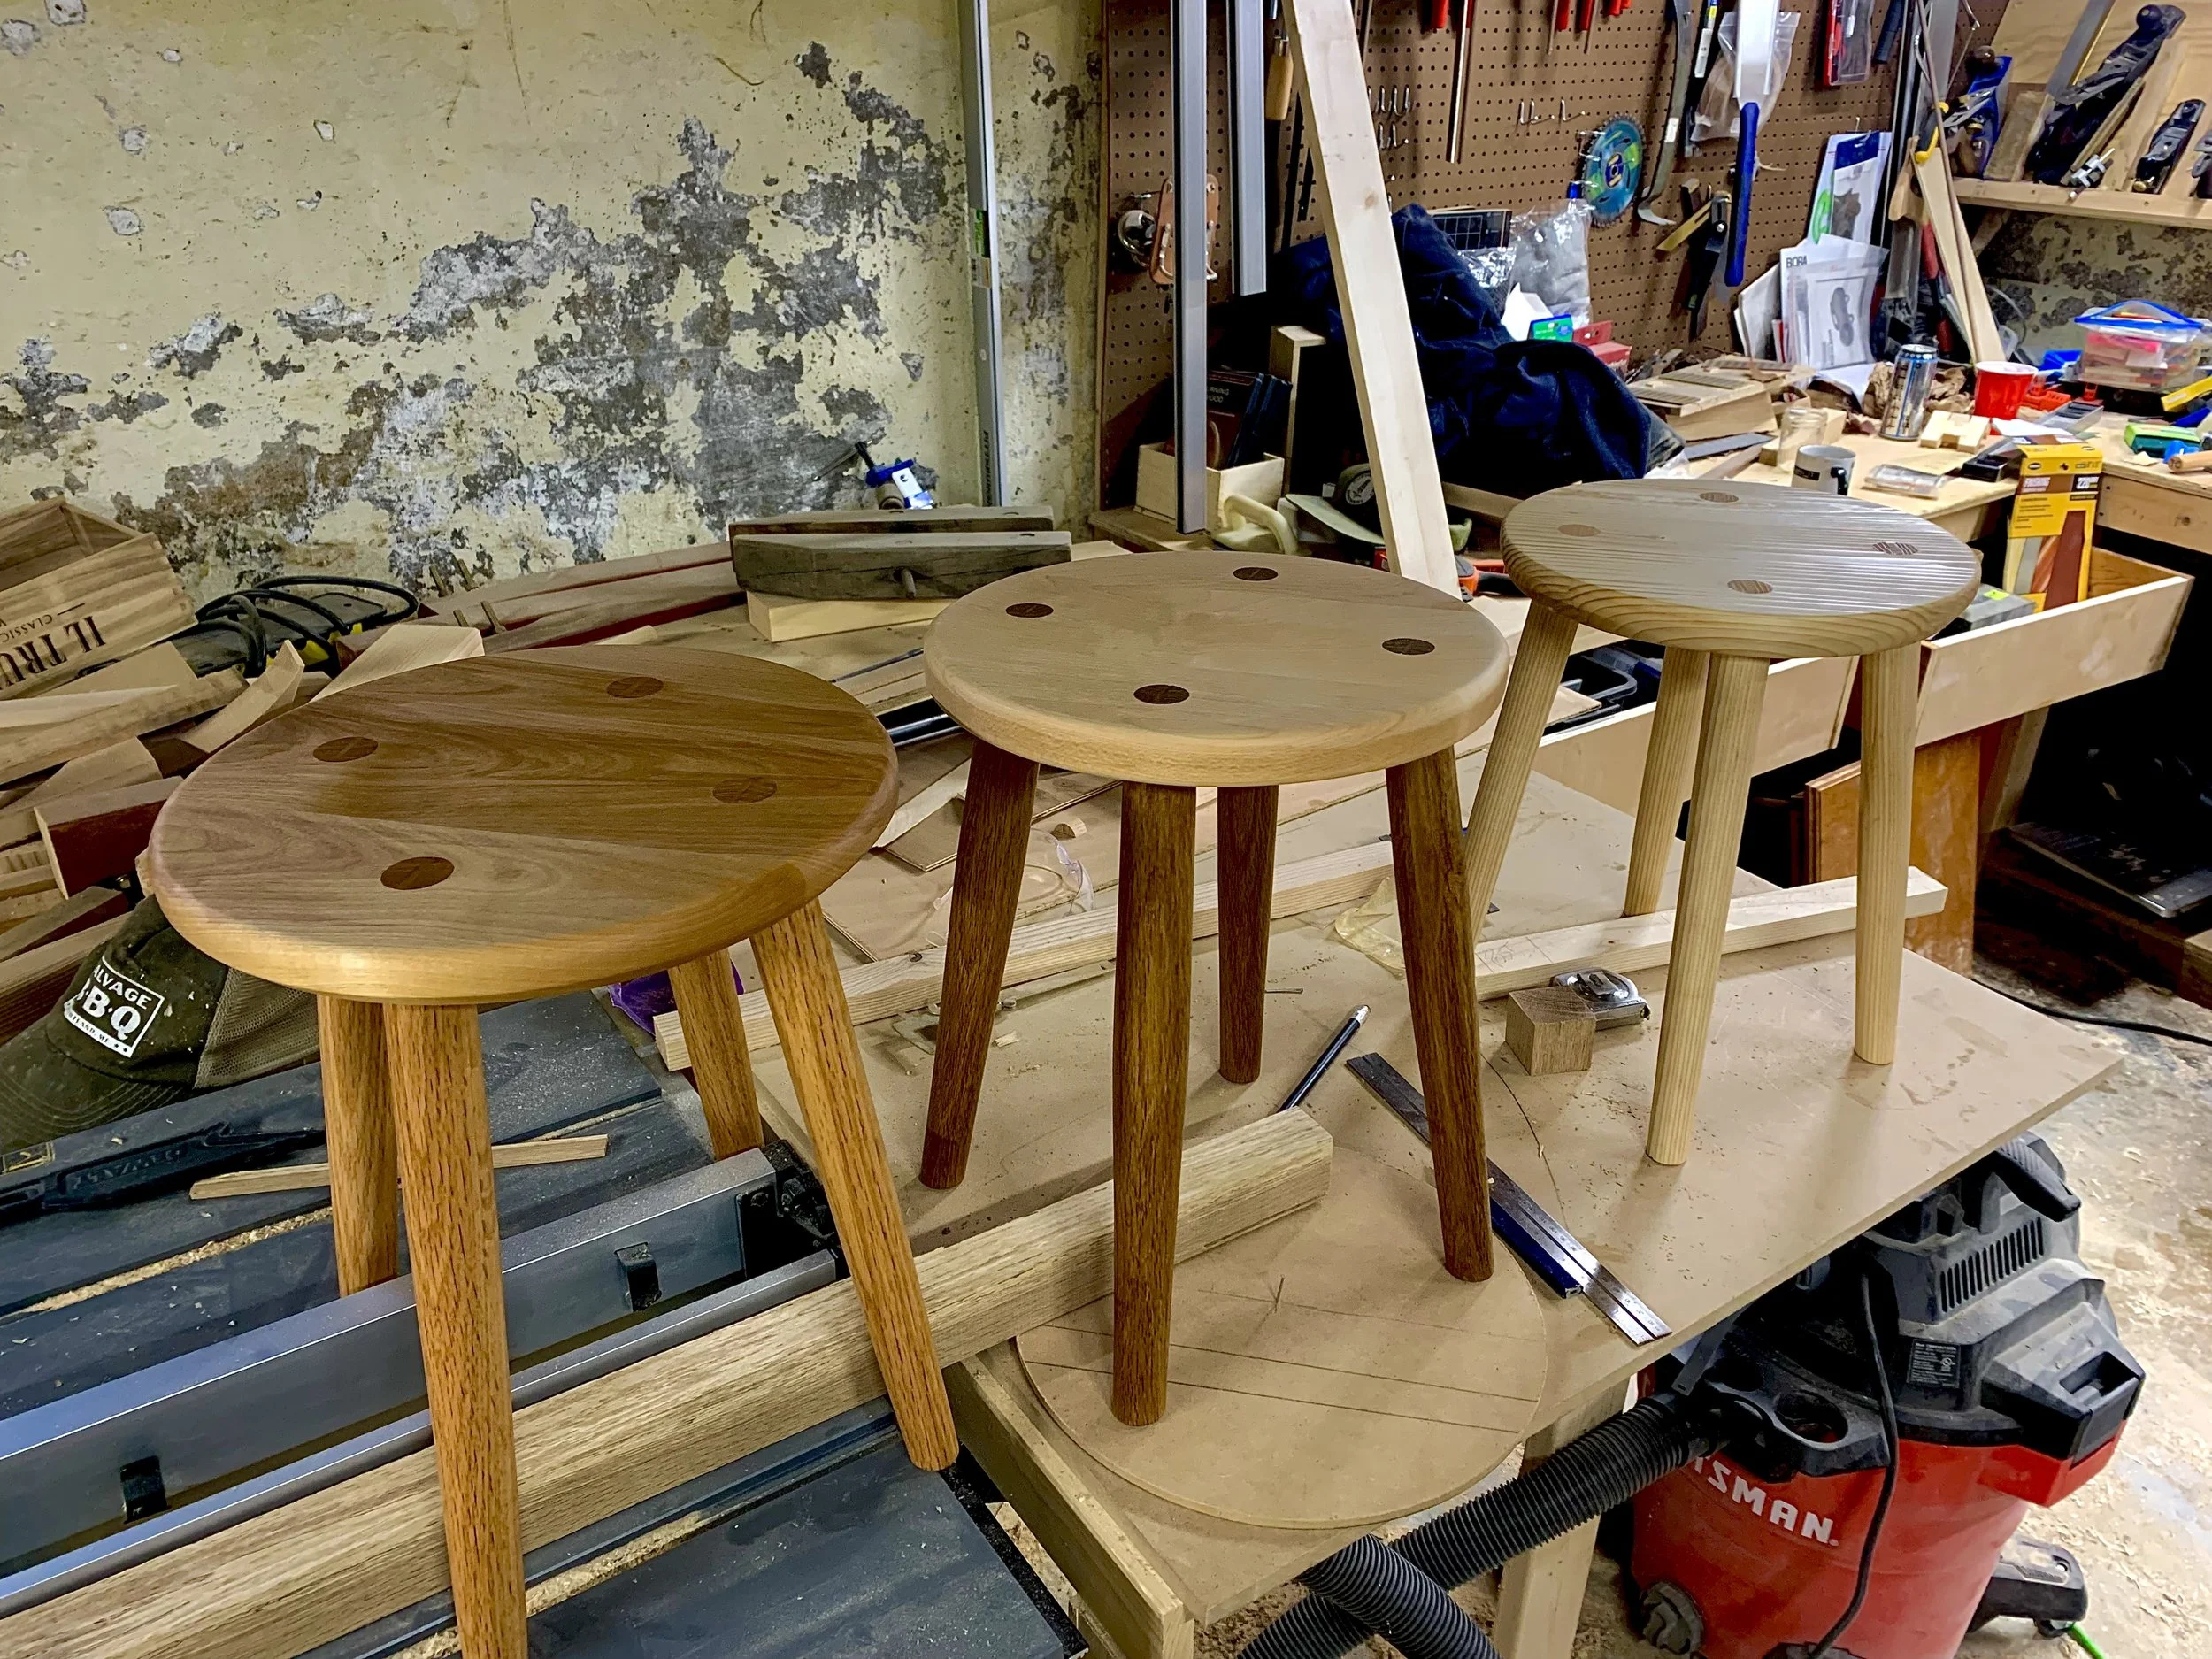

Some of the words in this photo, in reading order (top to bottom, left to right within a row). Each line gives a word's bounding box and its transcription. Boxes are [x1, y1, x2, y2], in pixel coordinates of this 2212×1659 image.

[1209, 386, 1230, 396] RNING
[0, 614, 53, 642] CLASSIC
[63, 616, 106, 653] IL
[0, 634, 67, 690] TRU
[93, 964, 152, 1010] ALVAGE
